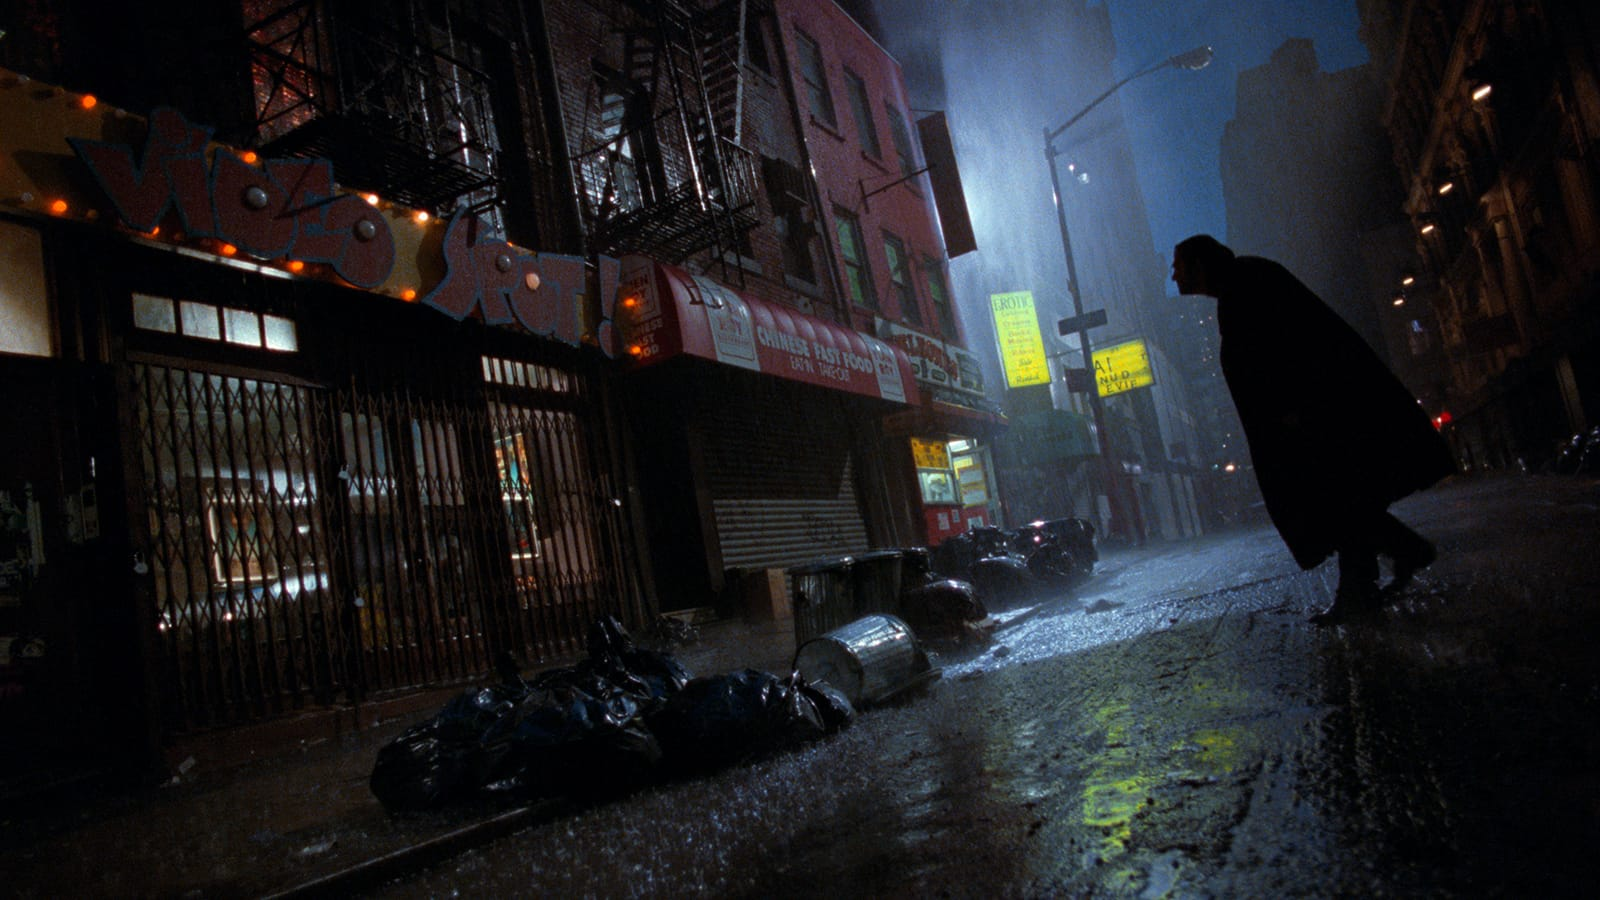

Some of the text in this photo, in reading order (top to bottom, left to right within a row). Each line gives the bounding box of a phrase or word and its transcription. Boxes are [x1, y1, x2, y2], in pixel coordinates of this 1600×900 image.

[993, 295, 1032, 311] EROTIC
[757, 325, 809, 357] CHINESE
[814, 342, 842, 367] FAST
[843, 352, 873, 375] FOOD
